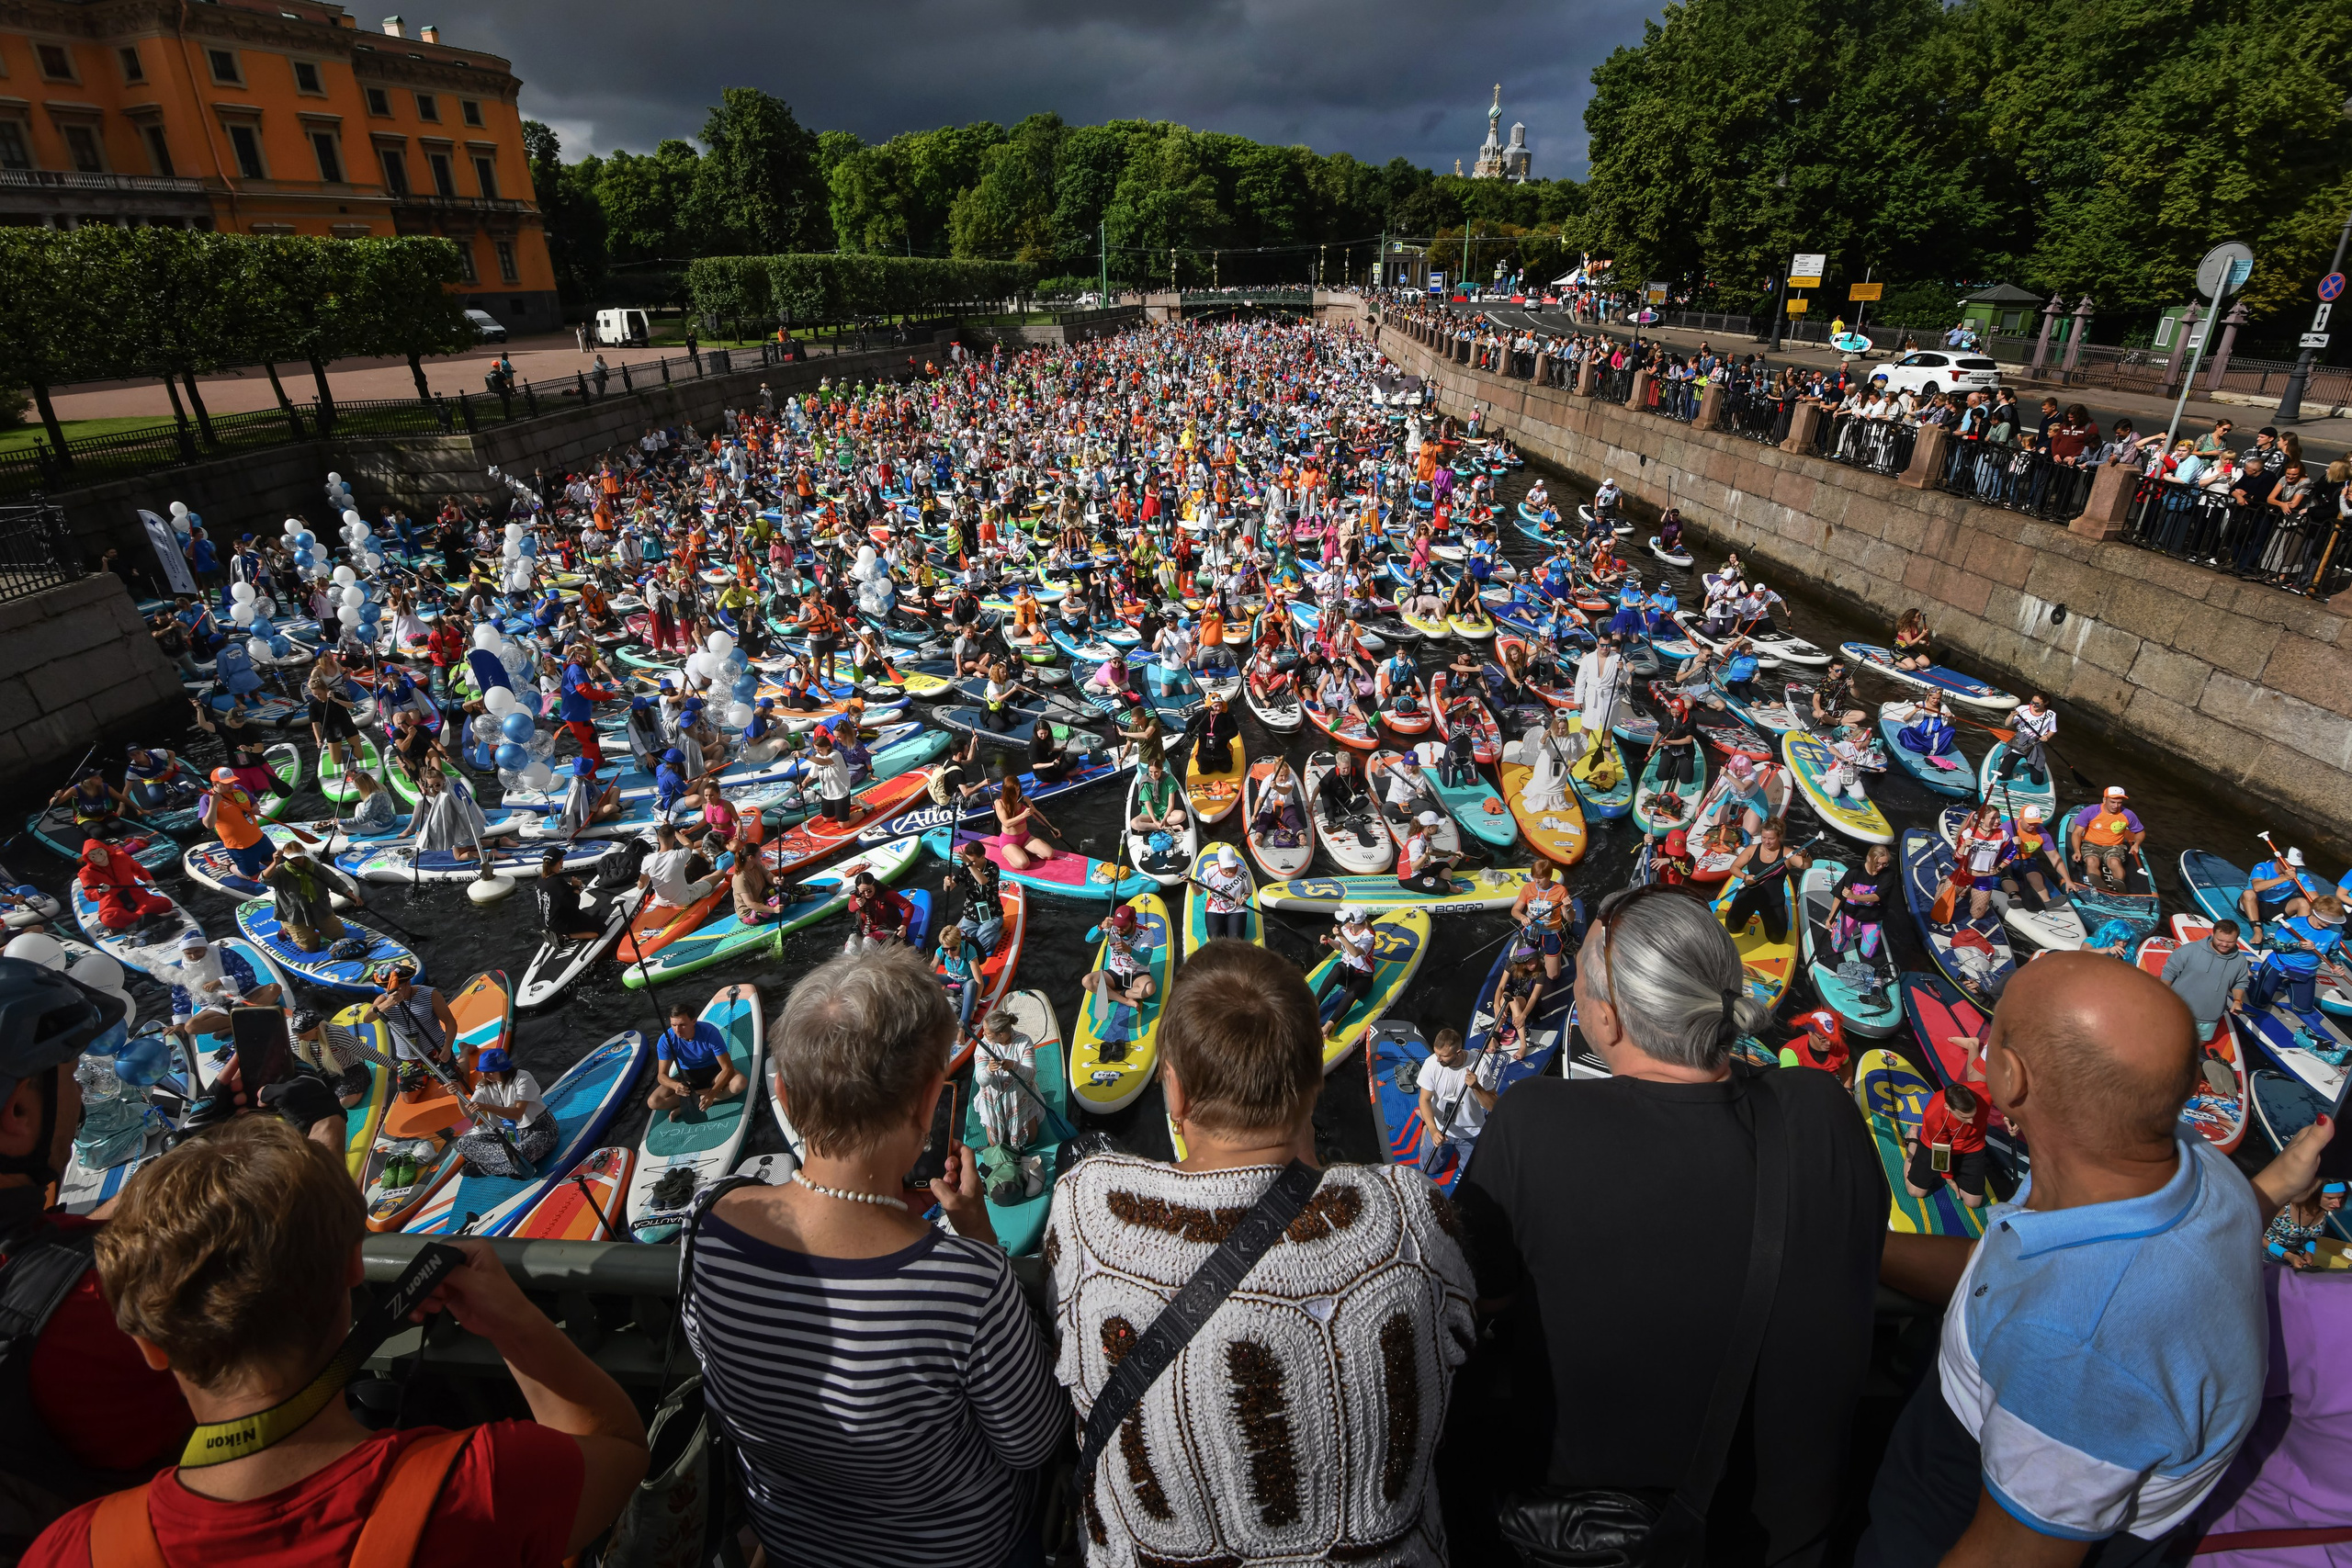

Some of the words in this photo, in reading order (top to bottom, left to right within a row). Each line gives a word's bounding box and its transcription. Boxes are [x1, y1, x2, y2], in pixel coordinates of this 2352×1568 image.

[892, 806, 967, 834] Atlas
[1213, 870, 1249, 900] SlGroup
[1435, 903, 1484, 913] BOARD
[659, 1122, 729, 1137] NAUTICA
[405, 1254, 443, 1294] Nikon
[206, 1427, 256, 1449] Nikon
